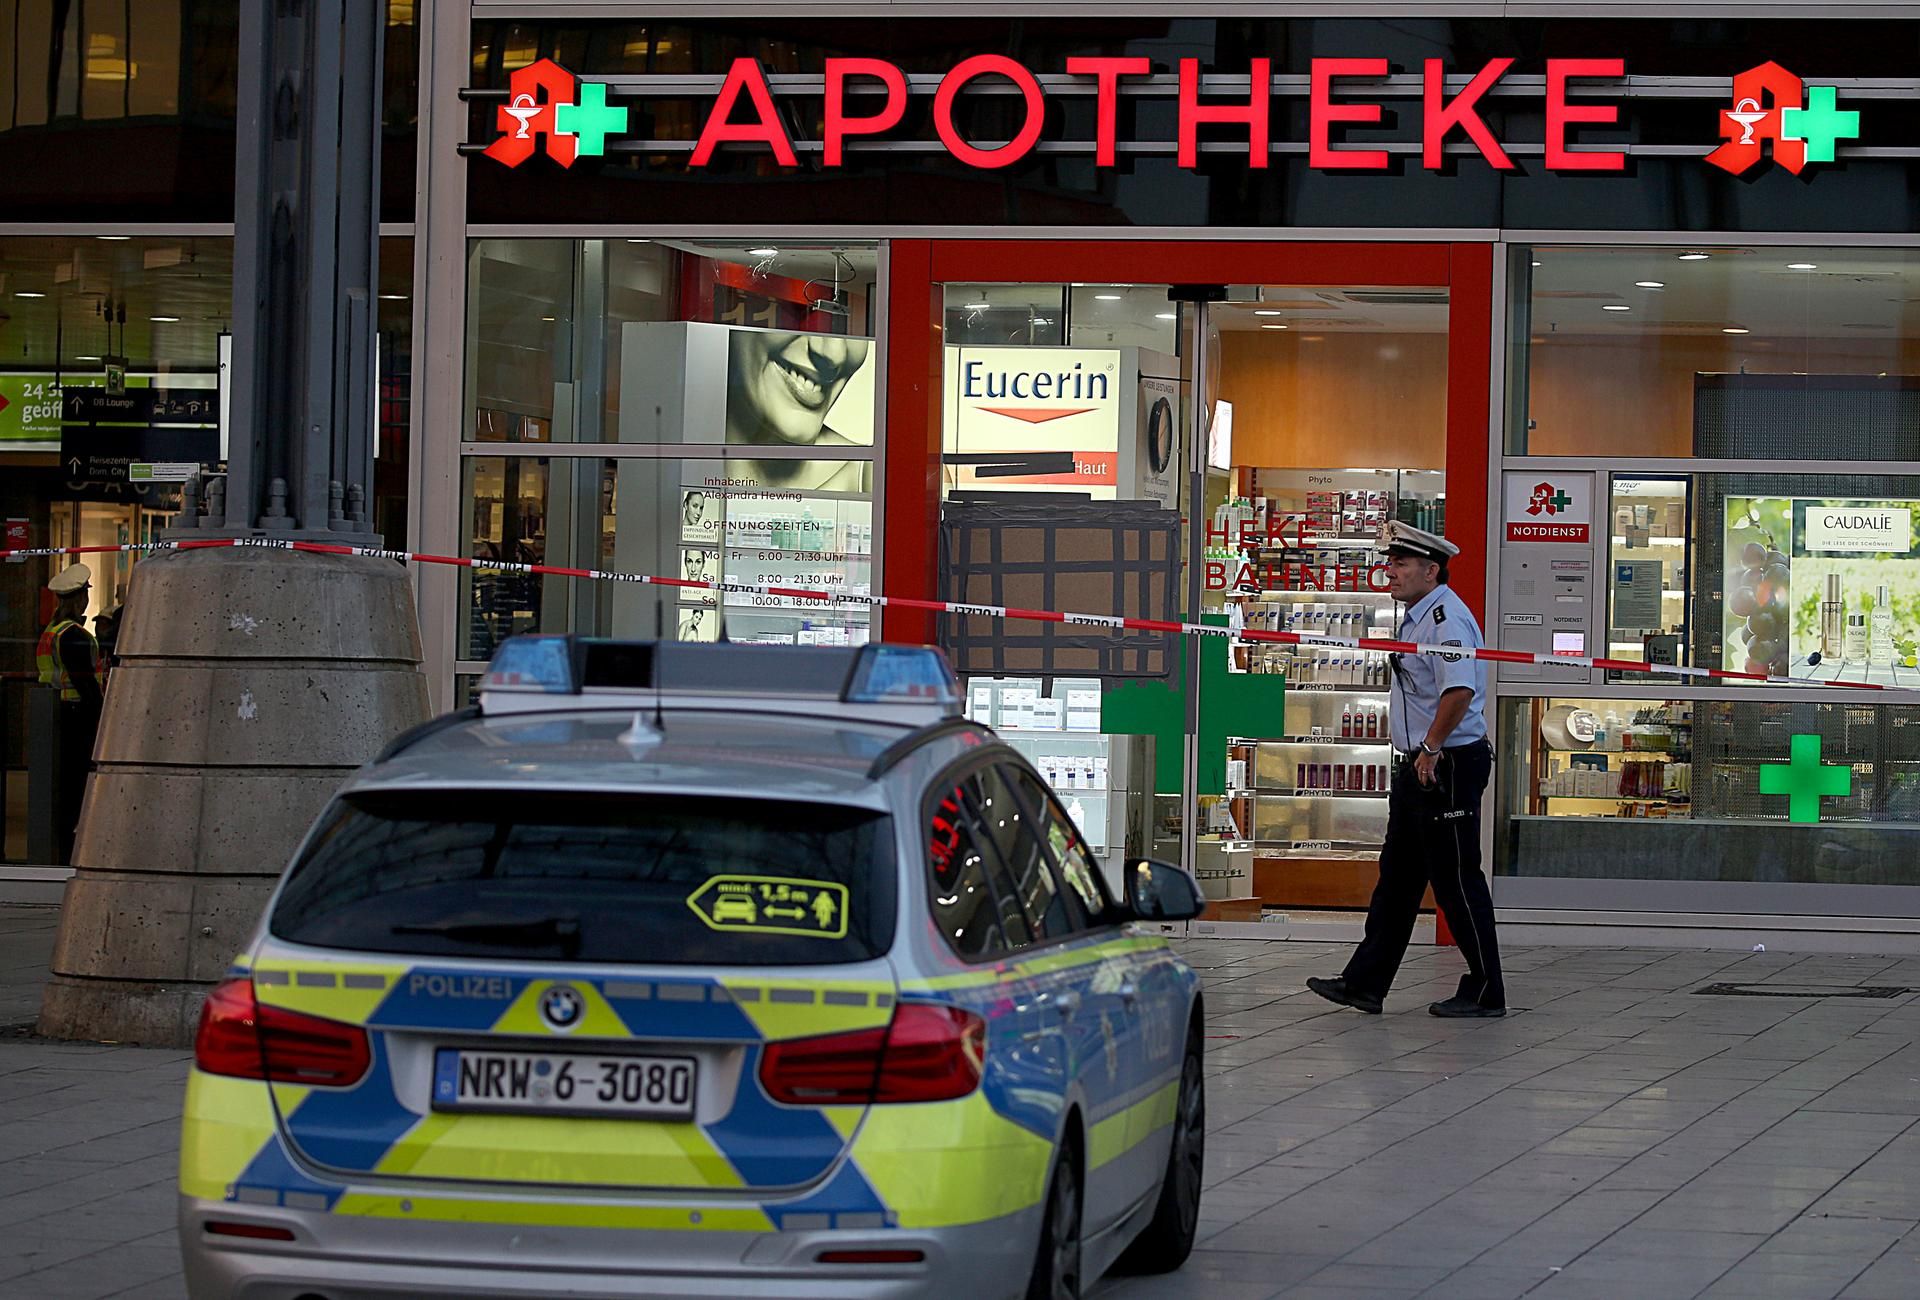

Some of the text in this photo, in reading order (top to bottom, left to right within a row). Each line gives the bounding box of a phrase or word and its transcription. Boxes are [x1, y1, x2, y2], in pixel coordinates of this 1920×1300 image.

[688, 54, 1625, 169] APOTHEKE
[964, 362, 1108, 399] Eucerin
[23, 383, 44, 400] 24
[106, 398, 135, 409] Lounge
[90, 456, 141, 464] Reisezentrum
[111, 467, 126, 477] City
[1074, 460, 1107, 475] Haut
[704, 477, 759, 487] Inhaberin:
[1308, 475, 1333, 485] Phyto
[704, 491, 802, 502] Alexandra Hewing
[703, 519, 820, 532] ÖFFNUNGSZEITEN
[1206, 519, 1318, 549] HEKE
[1312, 531, 1338, 539] HYTO
[1513, 526, 1584, 537] NOTDIENST
[704, 551, 720, 561] Mo
[732, 551, 743, 561] Fr
[758, 551, 783, 561] 6.00
[794, 552, 821, 562] 21.30
[824, 552, 844, 562] Uhr
[702, 573, 715, 583] Sa
[757, 574, 782, 584] 8.00
[793, 575, 821, 584] 21.30
[824, 575, 843, 585] Uhr
[1308, 584, 1335, 592] PHTO
[702, 596, 717, 605] So
[751, 597, 780, 606] 10.00
[1653, 647, 1668, 655] tax
[1305, 683, 1334, 691] PHYTO
[1305, 735, 1334, 743] PHYTO
[1304, 789, 1333, 797] PHYTO
[1443, 810, 1465, 819] POLIZEI
[1302, 841, 1331, 849] PHYTO
[409, 974, 512, 998] POLIZEI
[458, 1057, 533, 1099] NRW
[554, 1060, 690, 1106] 6-3080
